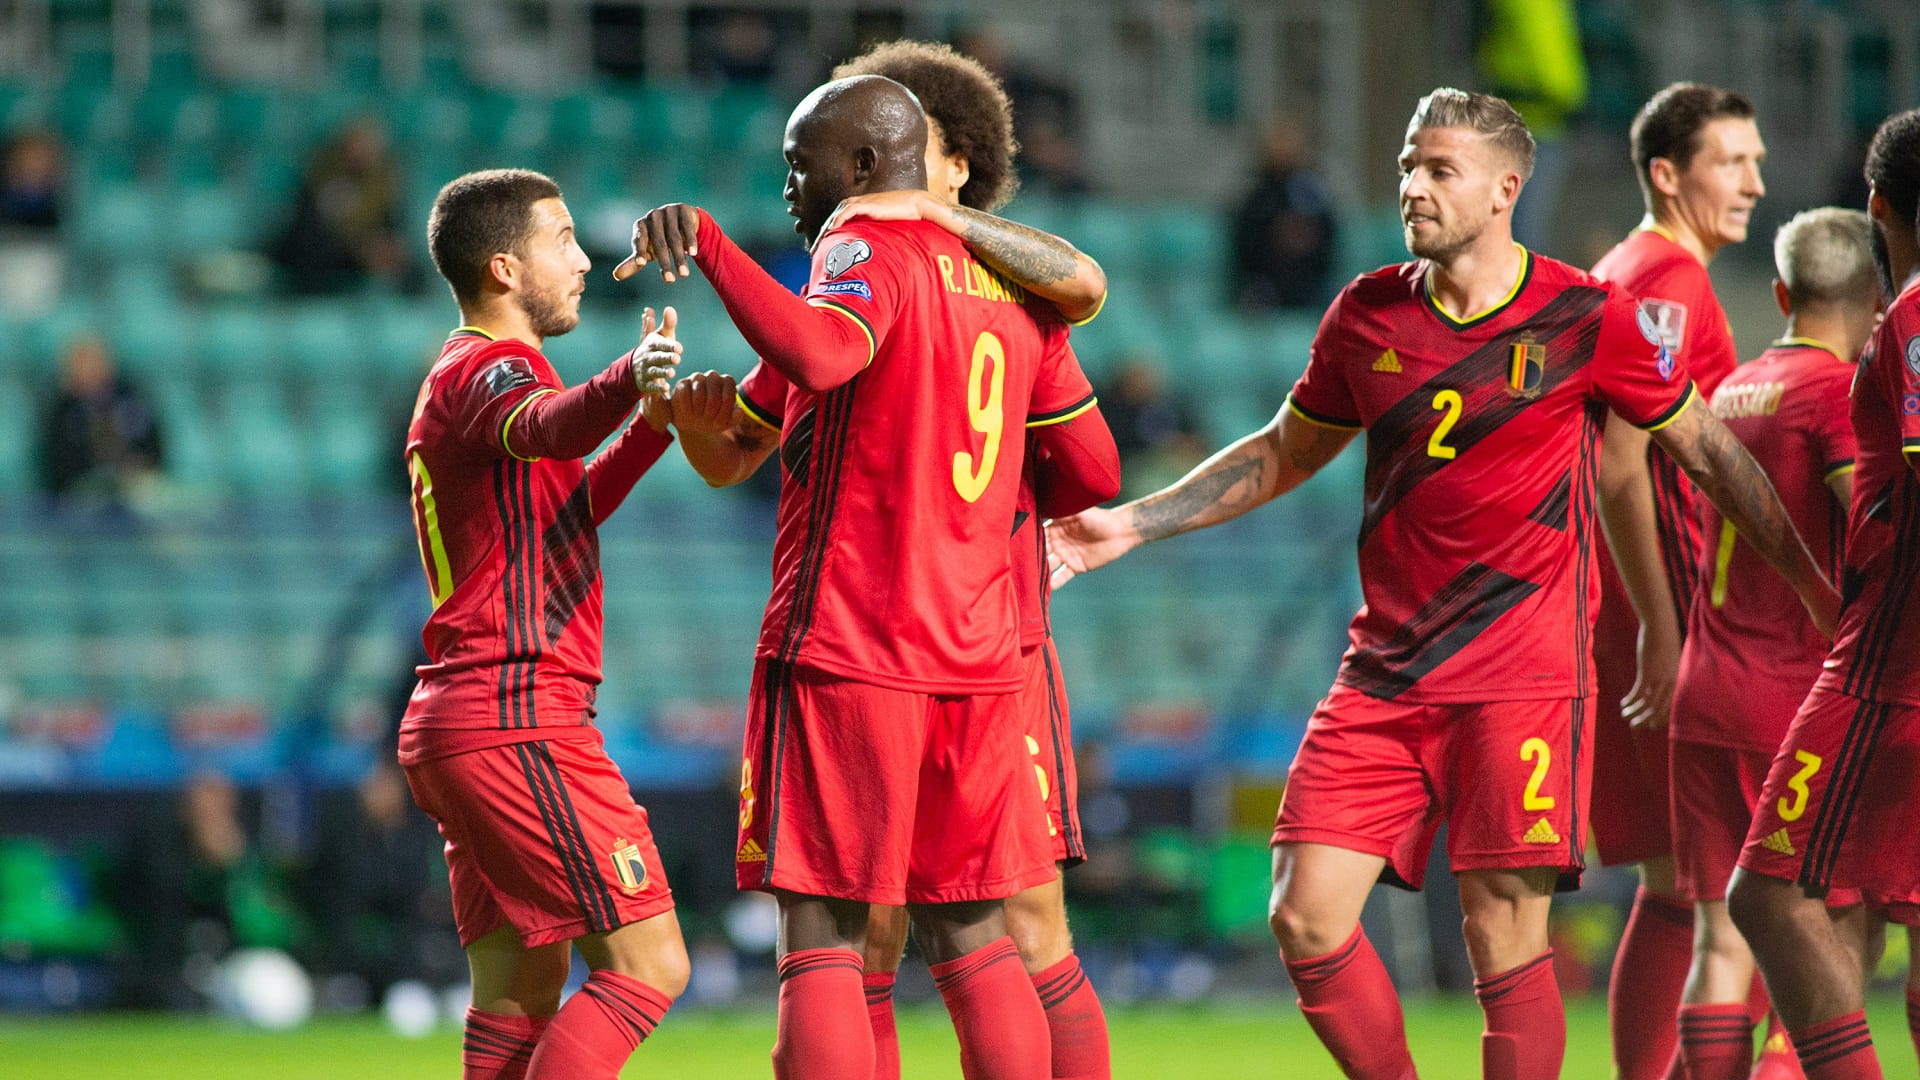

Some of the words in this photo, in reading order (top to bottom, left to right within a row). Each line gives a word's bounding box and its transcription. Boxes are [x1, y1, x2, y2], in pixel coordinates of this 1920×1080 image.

[938, 254, 962, 294] R.
[953, 331, 1005, 503] 9
[1427, 389, 1463, 459] 2
[740, 758, 754, 829] 9
[1520, 737, 1555, 811] 2
[1777, 749, 1822, 822] 3
